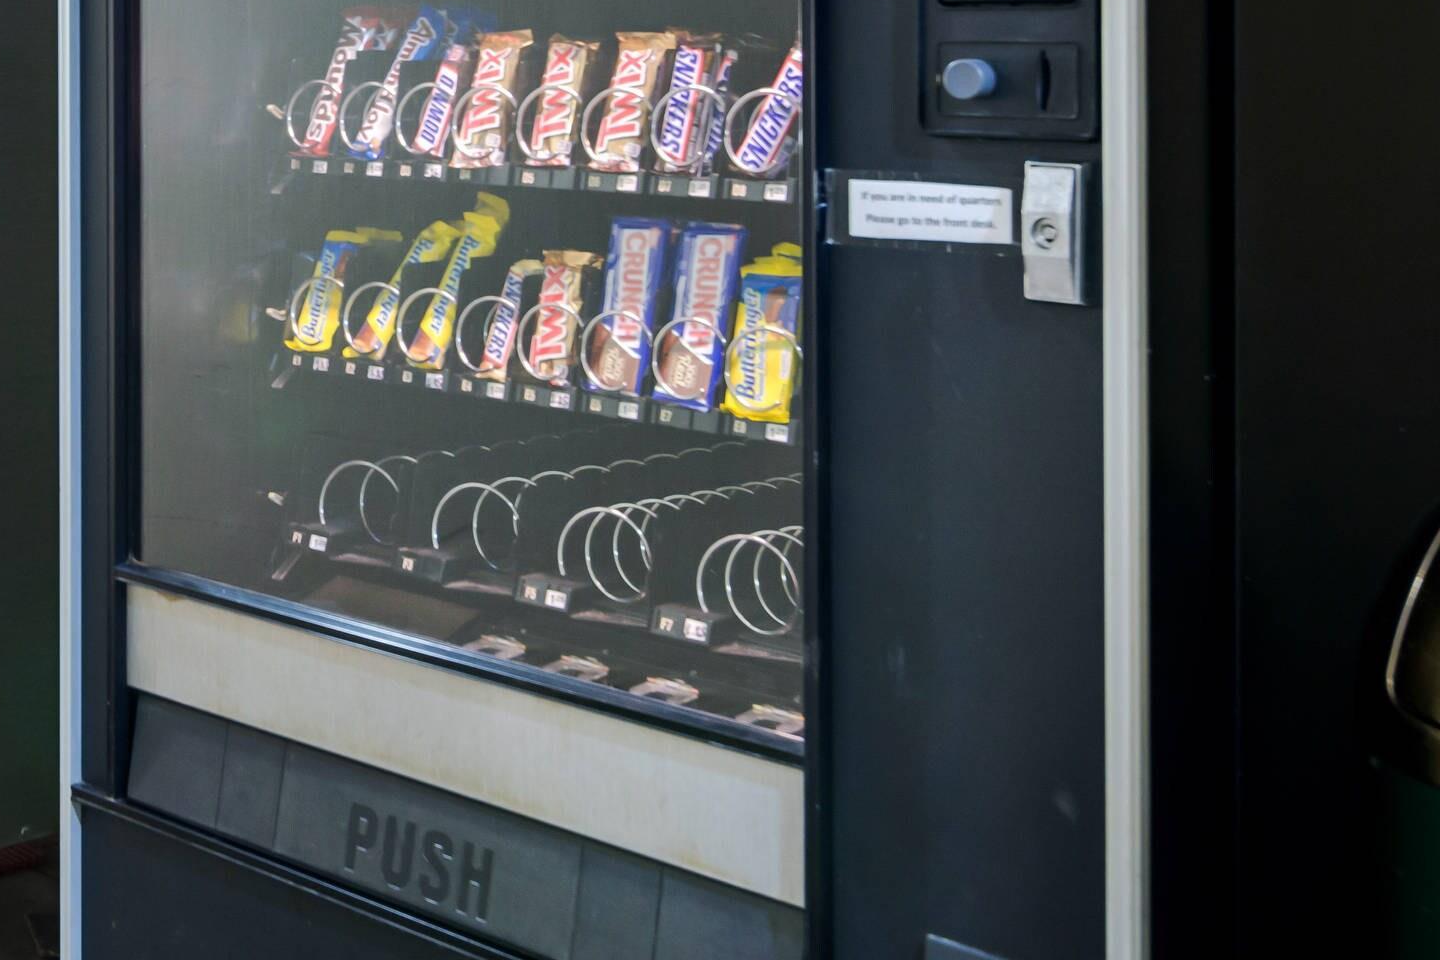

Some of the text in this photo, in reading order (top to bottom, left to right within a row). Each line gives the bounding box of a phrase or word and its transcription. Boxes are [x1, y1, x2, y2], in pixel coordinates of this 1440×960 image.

[307, 16, 363, 141] Mounds
[461, 47, 511, 145] TWIX
[531, 47, 574, 151] TWIX
[596, 49, 651, 153] TWIX
[661, 46, 698, 154] SNICKERS
[740, 66, 802, 171] SNICKERS
[866, 213, 895, 225] Please
[896, 217, 909, 227] go
[911, 217, 921, 226] to
[924, 216, 940, 227] the
[944, 217, 968, 227] front
[870, 193, 888, 202] you
[890, 194, 905, 202] are
[906, 193, 917, 203] in
[919, 194, 943, 204] need
[946, 195, 958, 205] of
[529, 266, 569, 368] TWIX
[614, 231, 648, 349] CRUNCH
[683, 238, 722, 358] CRUNCH
[734, 287, 764, 401] Butterfinger
[343, 802, 495, 924] PUSH
